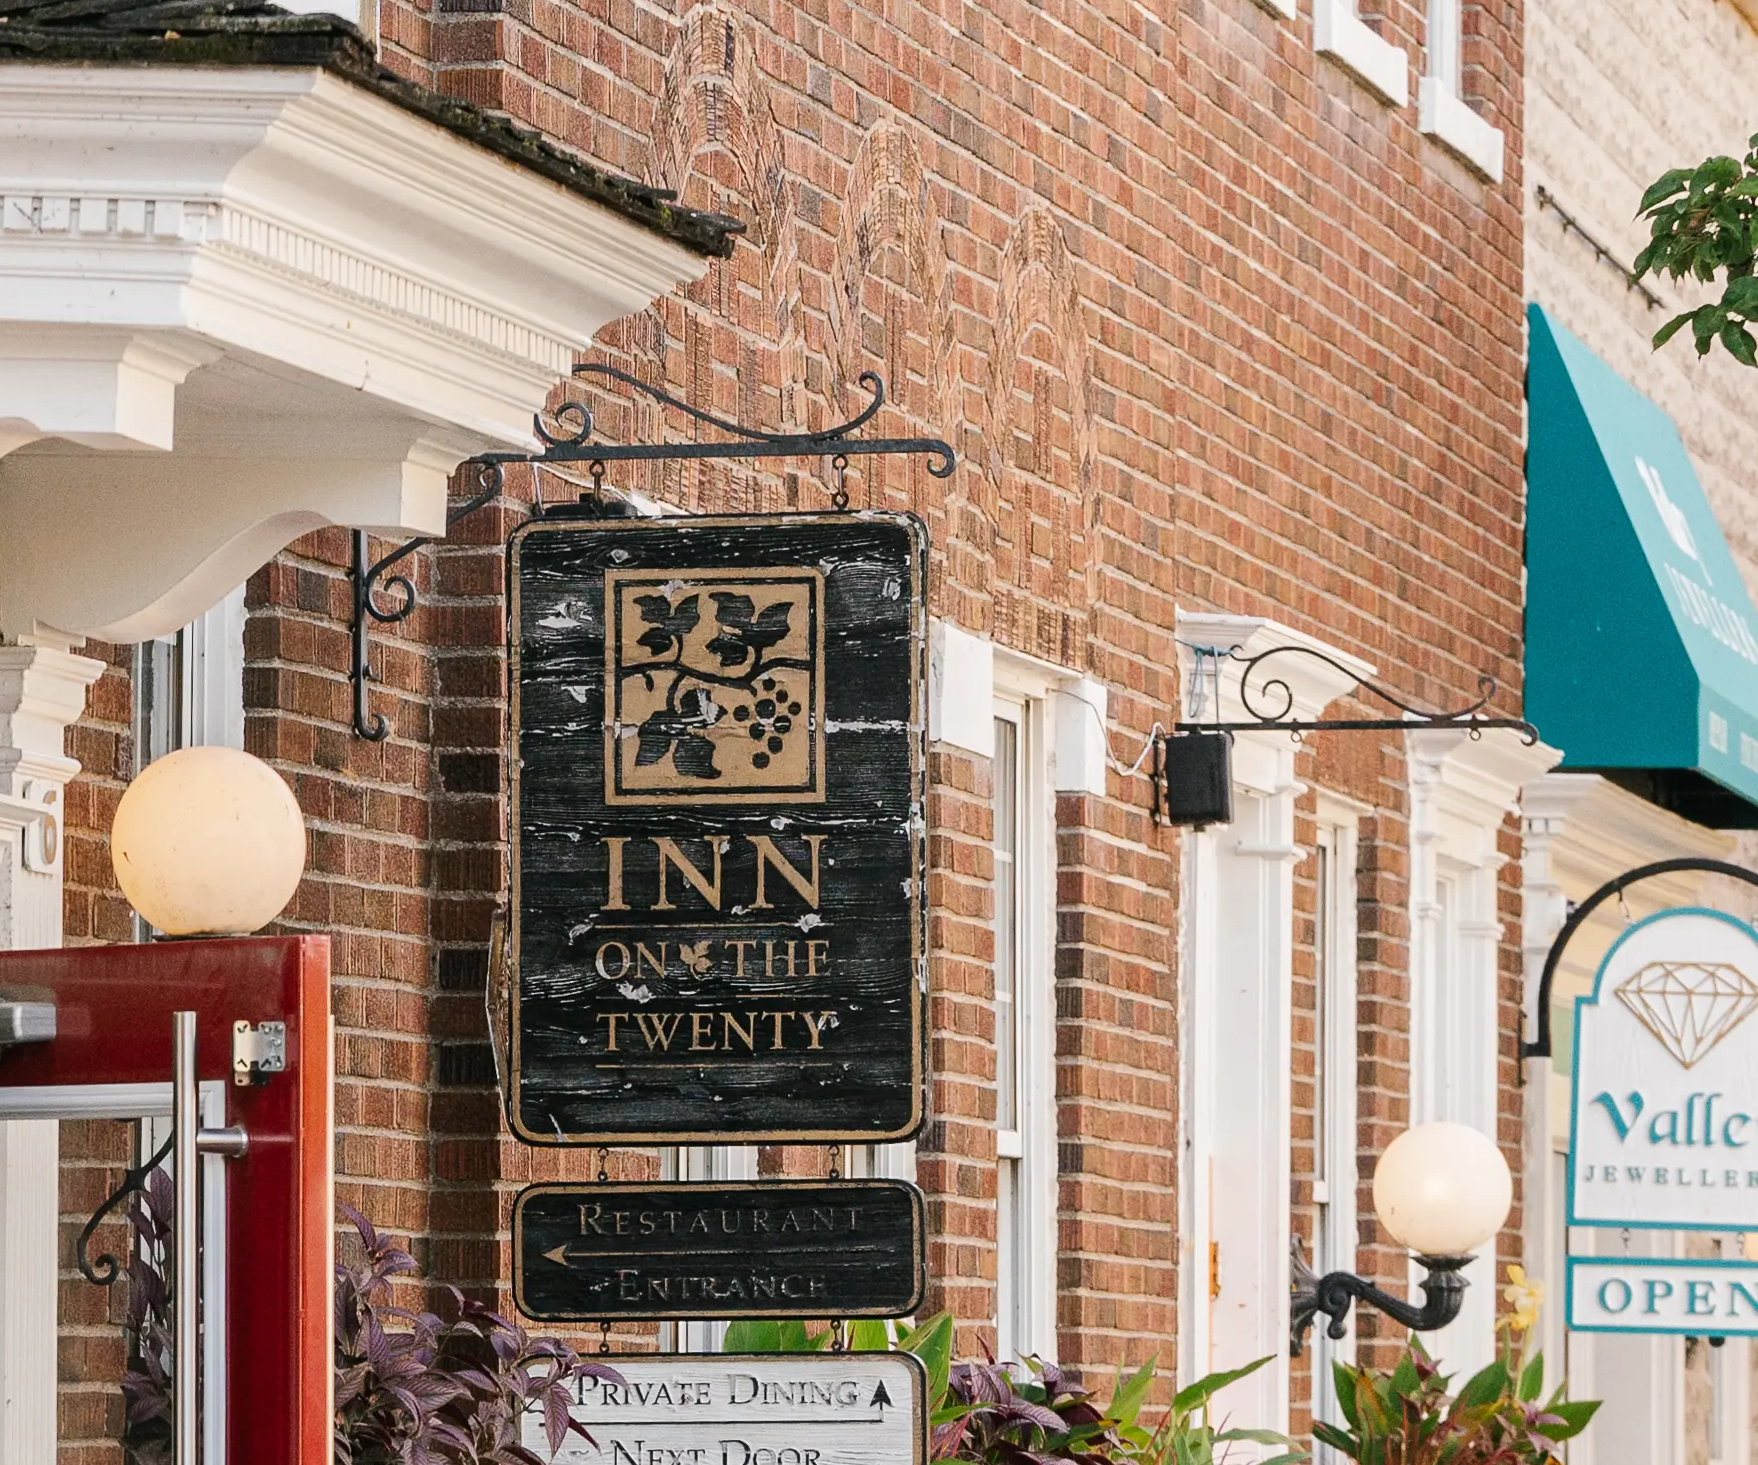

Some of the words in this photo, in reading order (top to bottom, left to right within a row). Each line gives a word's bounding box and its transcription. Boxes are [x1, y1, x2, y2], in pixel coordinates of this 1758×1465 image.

[600, 835, 828, 911] INN
[595, 941, 669, 980] ON
[724, 939, 832, 978] THE
[596, 1011, 838, 1051] TWENTY
[1589, 1091, 1758, 1148] Valle
[1585, 1165, 1758, 1188] JEWELLER
[1598, 1278, 1758, 1316] OPEN
